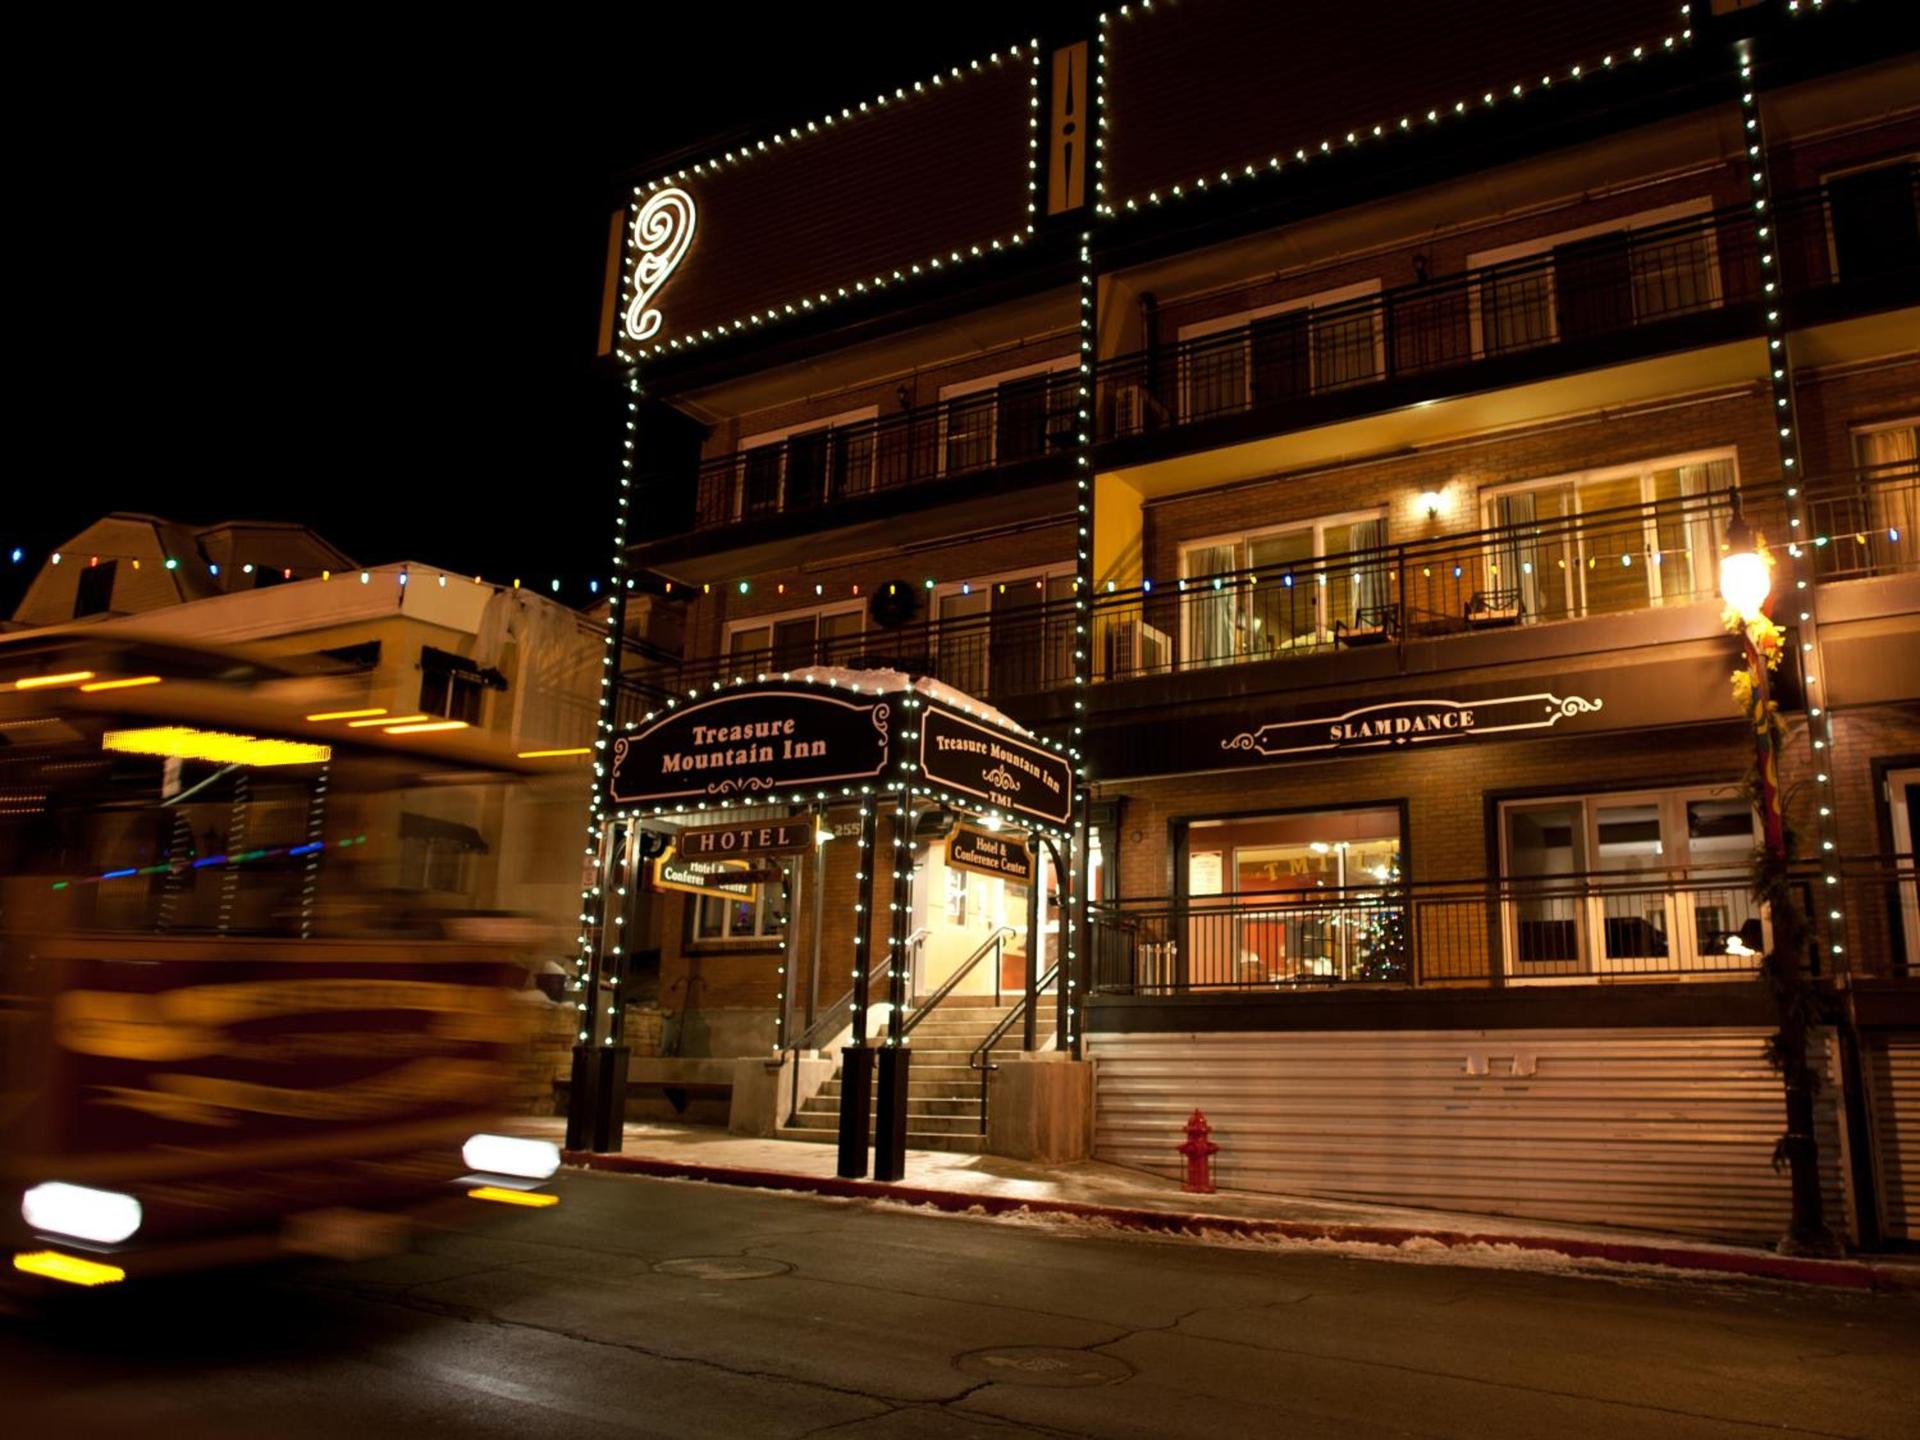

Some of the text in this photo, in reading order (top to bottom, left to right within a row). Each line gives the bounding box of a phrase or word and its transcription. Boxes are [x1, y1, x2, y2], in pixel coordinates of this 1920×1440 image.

[692, 719, 796, 745] Treasure
[1330, 710, 1475, 741] SLAMDANCE
[661, 739, 828, 773] Mountain Inn
[936, 735, 1060, 794] Treasure Mountain Inn
[989, 791, 1012, 808] TMI
[700, 827, 790, 851] HOTEL
[834, 822, 861, 837] 255
[976, 837, 1007, 857] Hotel &
[954, 847, 1027, 875] Conference Center
